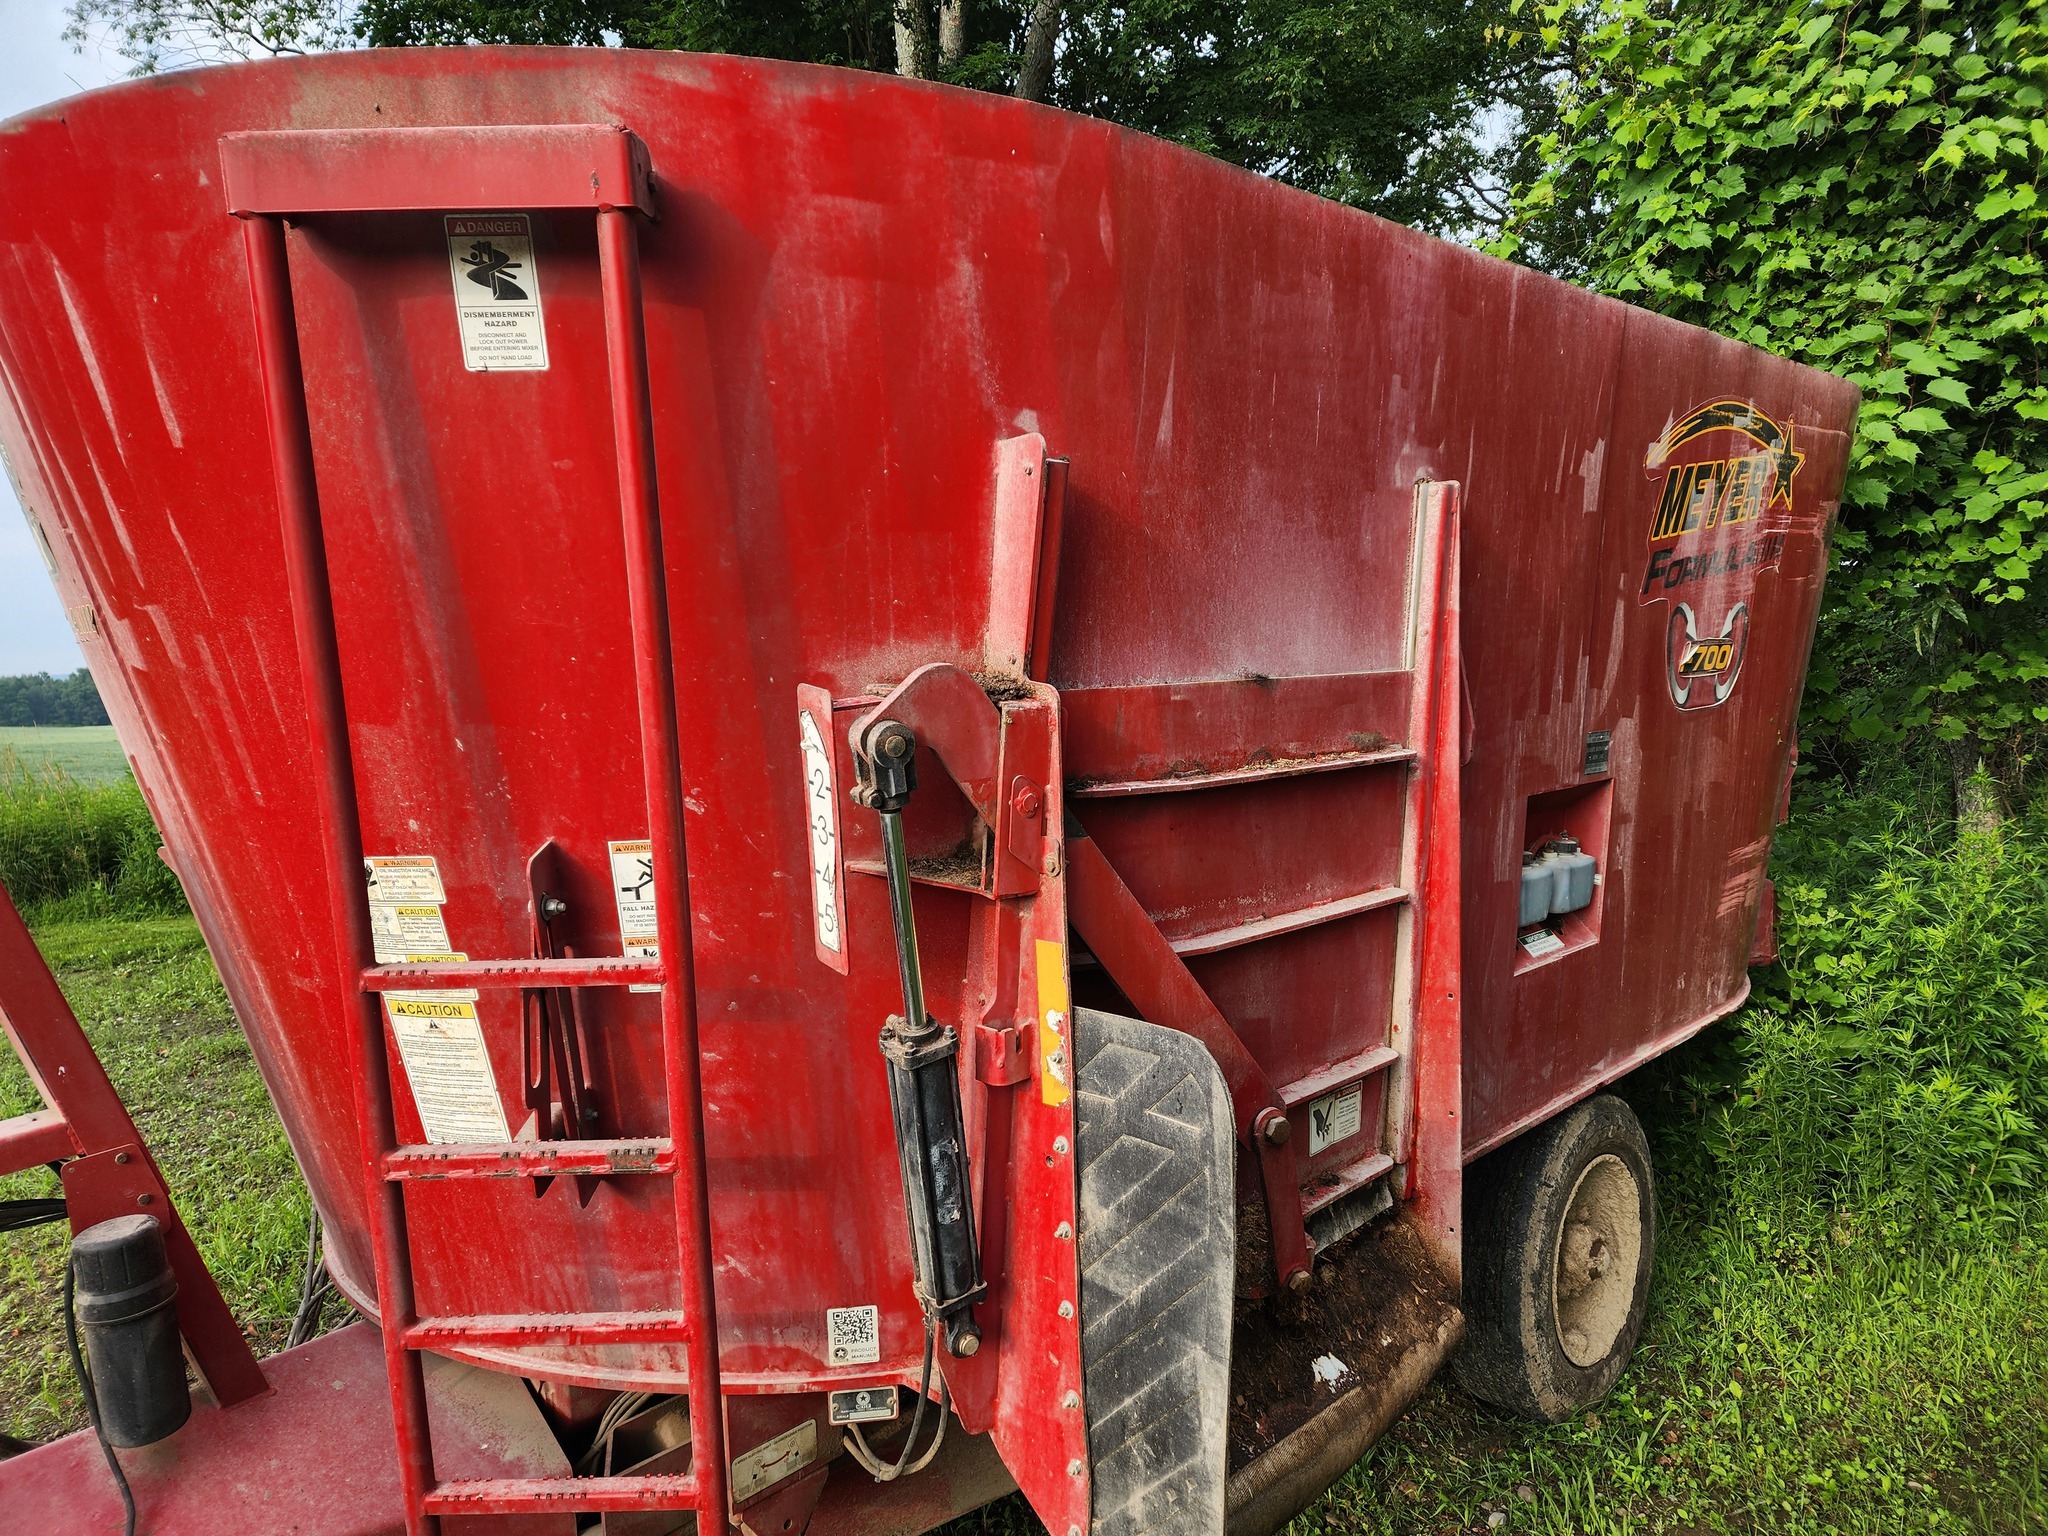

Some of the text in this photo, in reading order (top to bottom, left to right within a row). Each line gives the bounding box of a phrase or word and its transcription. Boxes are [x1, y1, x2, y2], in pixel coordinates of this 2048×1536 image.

[467, 222, 521, 233] DANGER
[1651, 455, 1770, 541] MEYER
[814, 768, 826, 799] 2
[817, 815, 828, 845] 3
[822, 862, 834, 890] 4
[405, 908, 437, 916] CAUTION
[824, 904, 834, 932] 5
[407, 1003, 462, 1016] CAUTION
